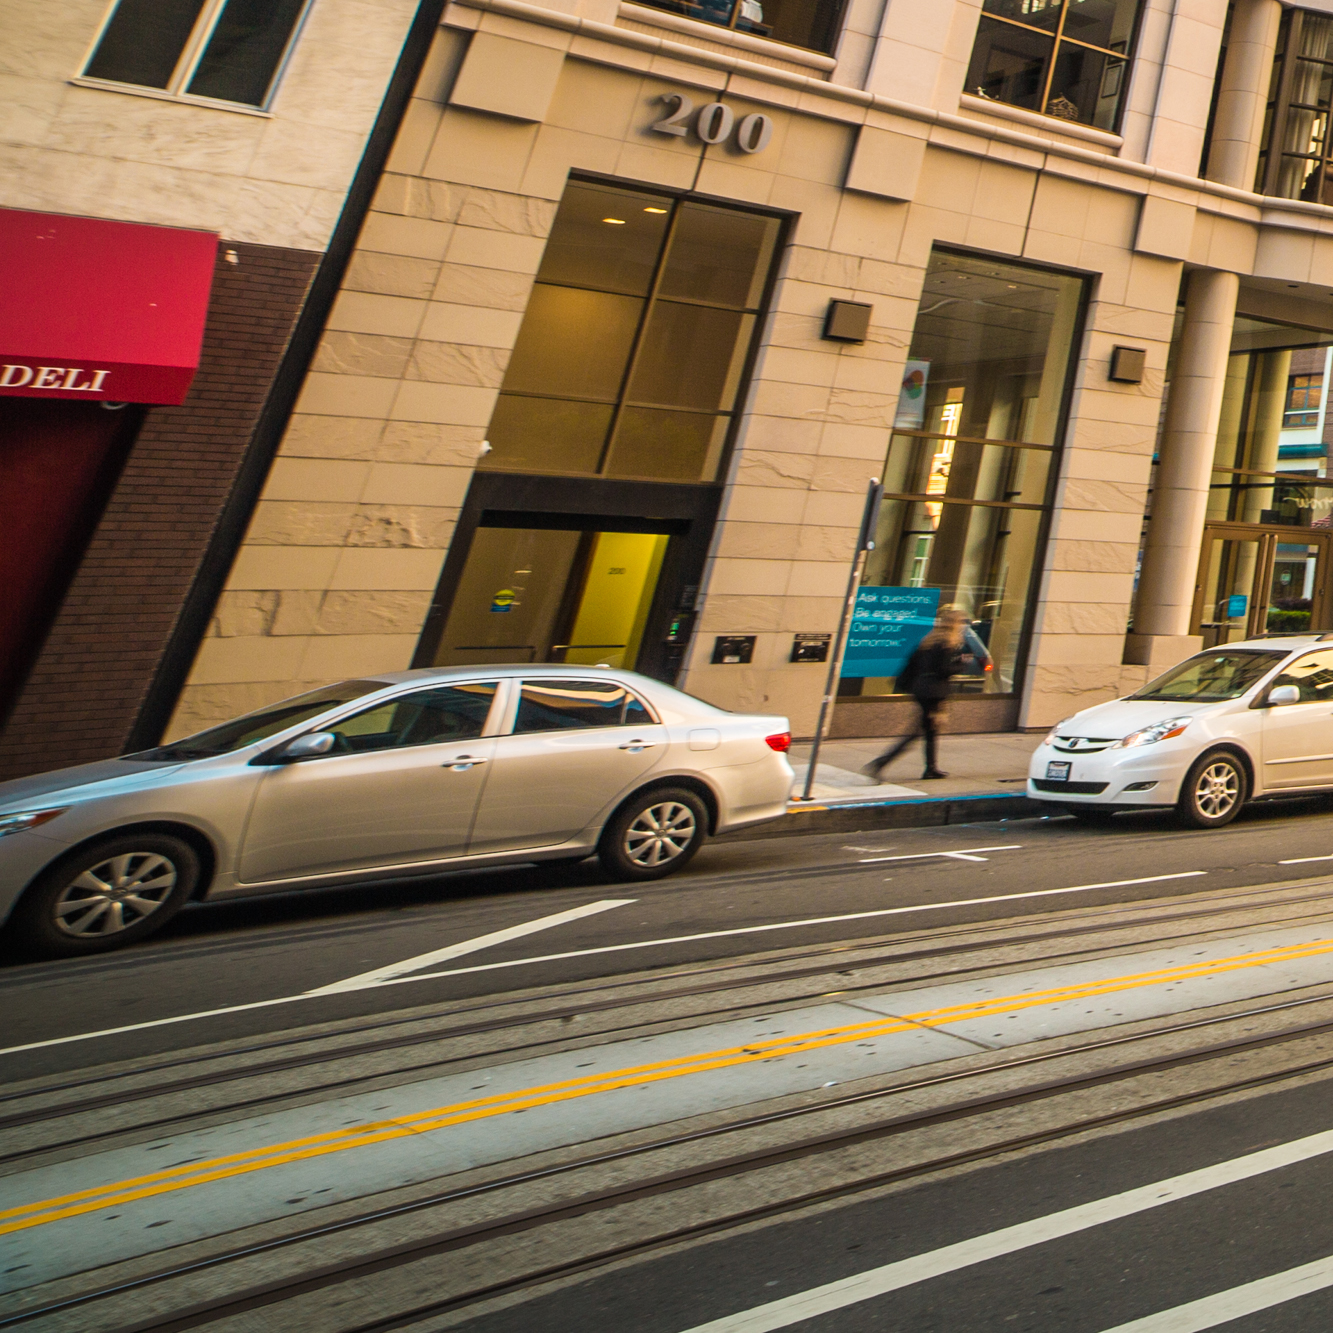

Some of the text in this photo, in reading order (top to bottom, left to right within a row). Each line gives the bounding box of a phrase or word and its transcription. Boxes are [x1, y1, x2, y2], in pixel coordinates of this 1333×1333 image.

[651, 93, 774, 154] 200
[0, 365, 112, 392] DELI
[858, 593, 878, 603] Ask
[855, 607, 870, 617] Be
[852, 622, 903, 635] Own your
